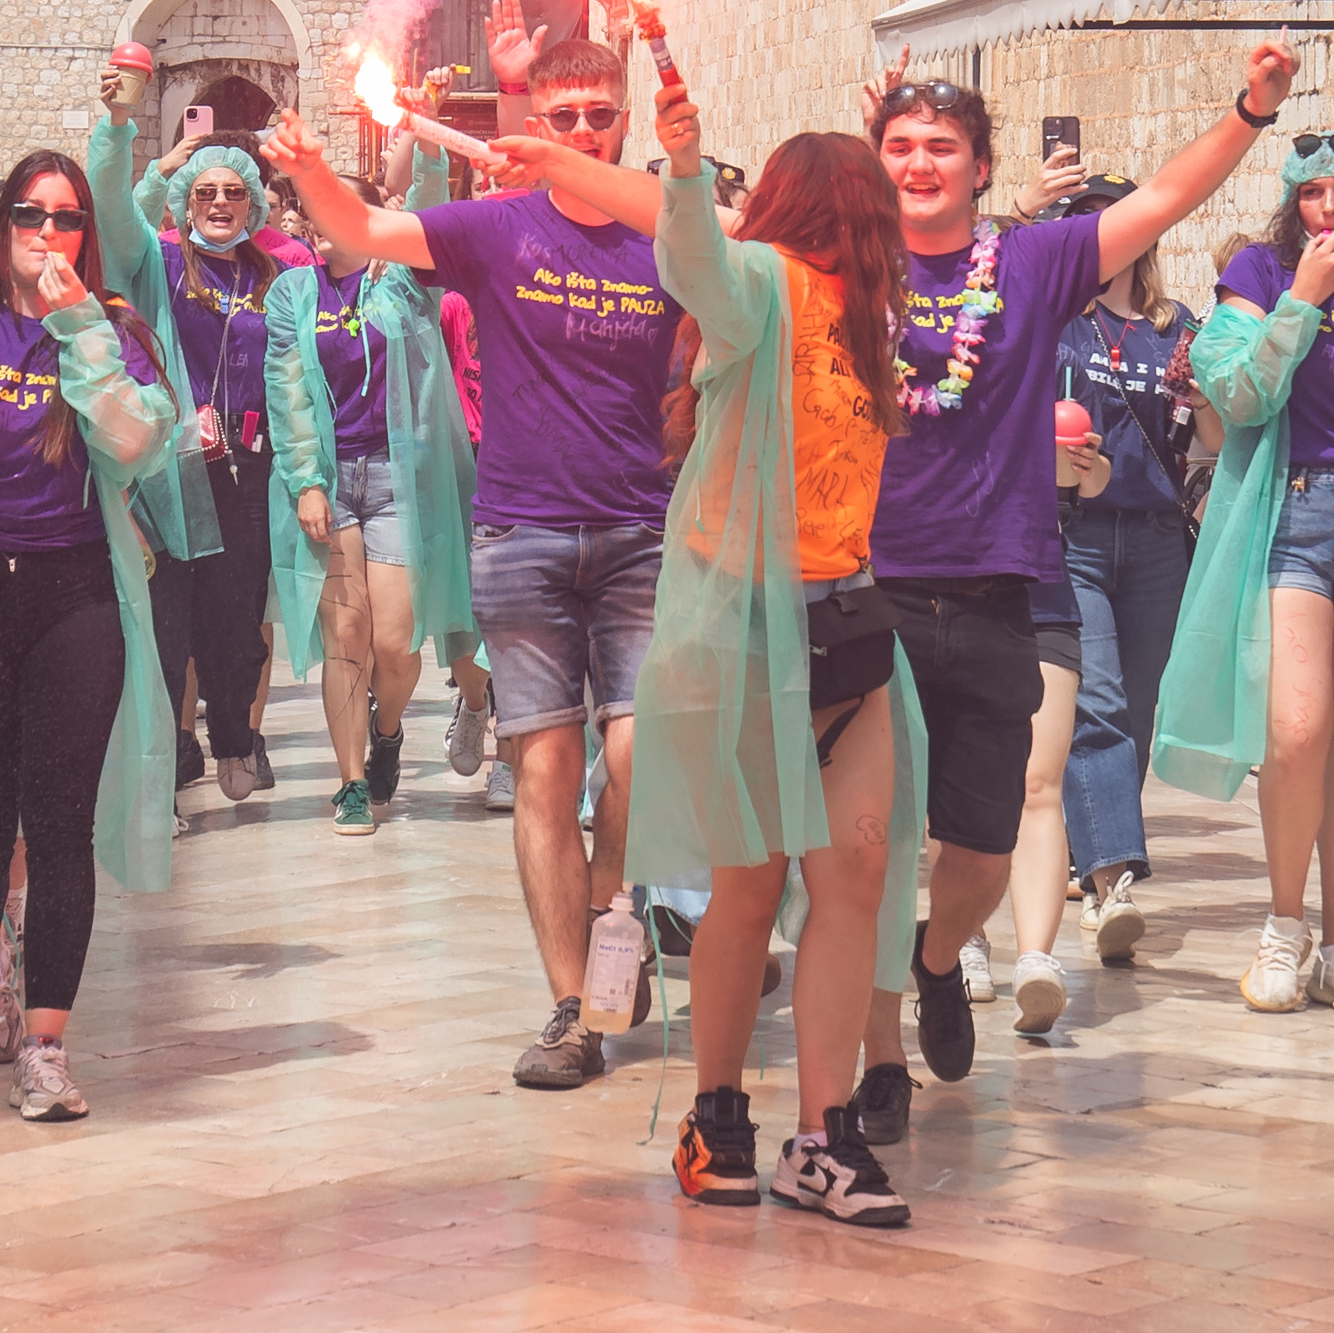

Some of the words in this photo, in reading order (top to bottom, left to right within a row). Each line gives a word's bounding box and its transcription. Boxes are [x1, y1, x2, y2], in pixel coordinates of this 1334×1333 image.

[534, 268, 562, 286] Ako
[566, 272, 597, 290] išta
[516, 286, 564, 304] znamo
[569, 293, 596, 309] kad
[597, 296, 615, 317] je
[620, 297, 666, 315] PAUZA
[936, 314, 954, 334] je
[1125, 380, 1146, 393] JE
[17, 391, 37, 410] je
